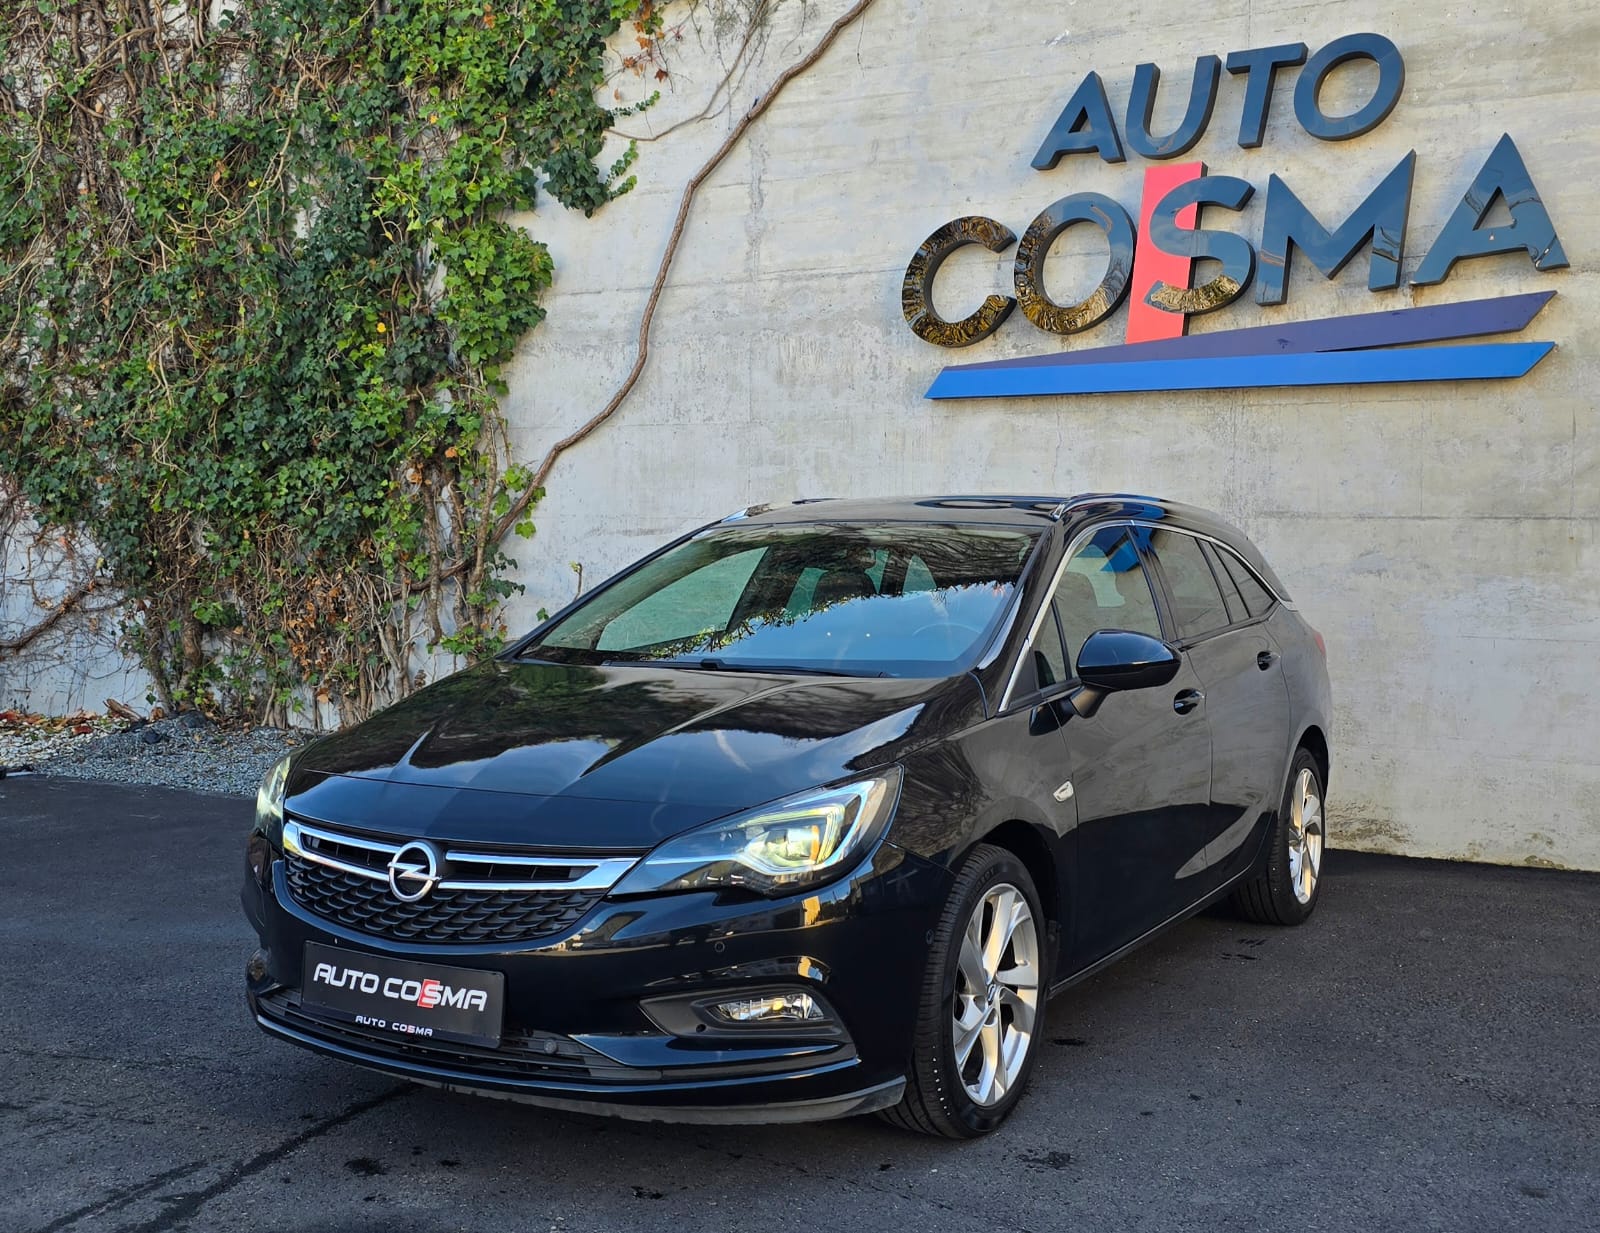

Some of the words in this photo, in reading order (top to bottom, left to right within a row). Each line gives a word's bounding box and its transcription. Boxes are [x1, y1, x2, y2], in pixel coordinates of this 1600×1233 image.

[1031, 32, 1405, 170] AUTO
[902, 132, 1569, 347] COSMA
[313, 962, 379, 993] AUTO
[383, 979, 487, 1011] COSMA
[355, 1015, 386, 1028] AUTO
[391, 1022, 433, 1037] COSMA
